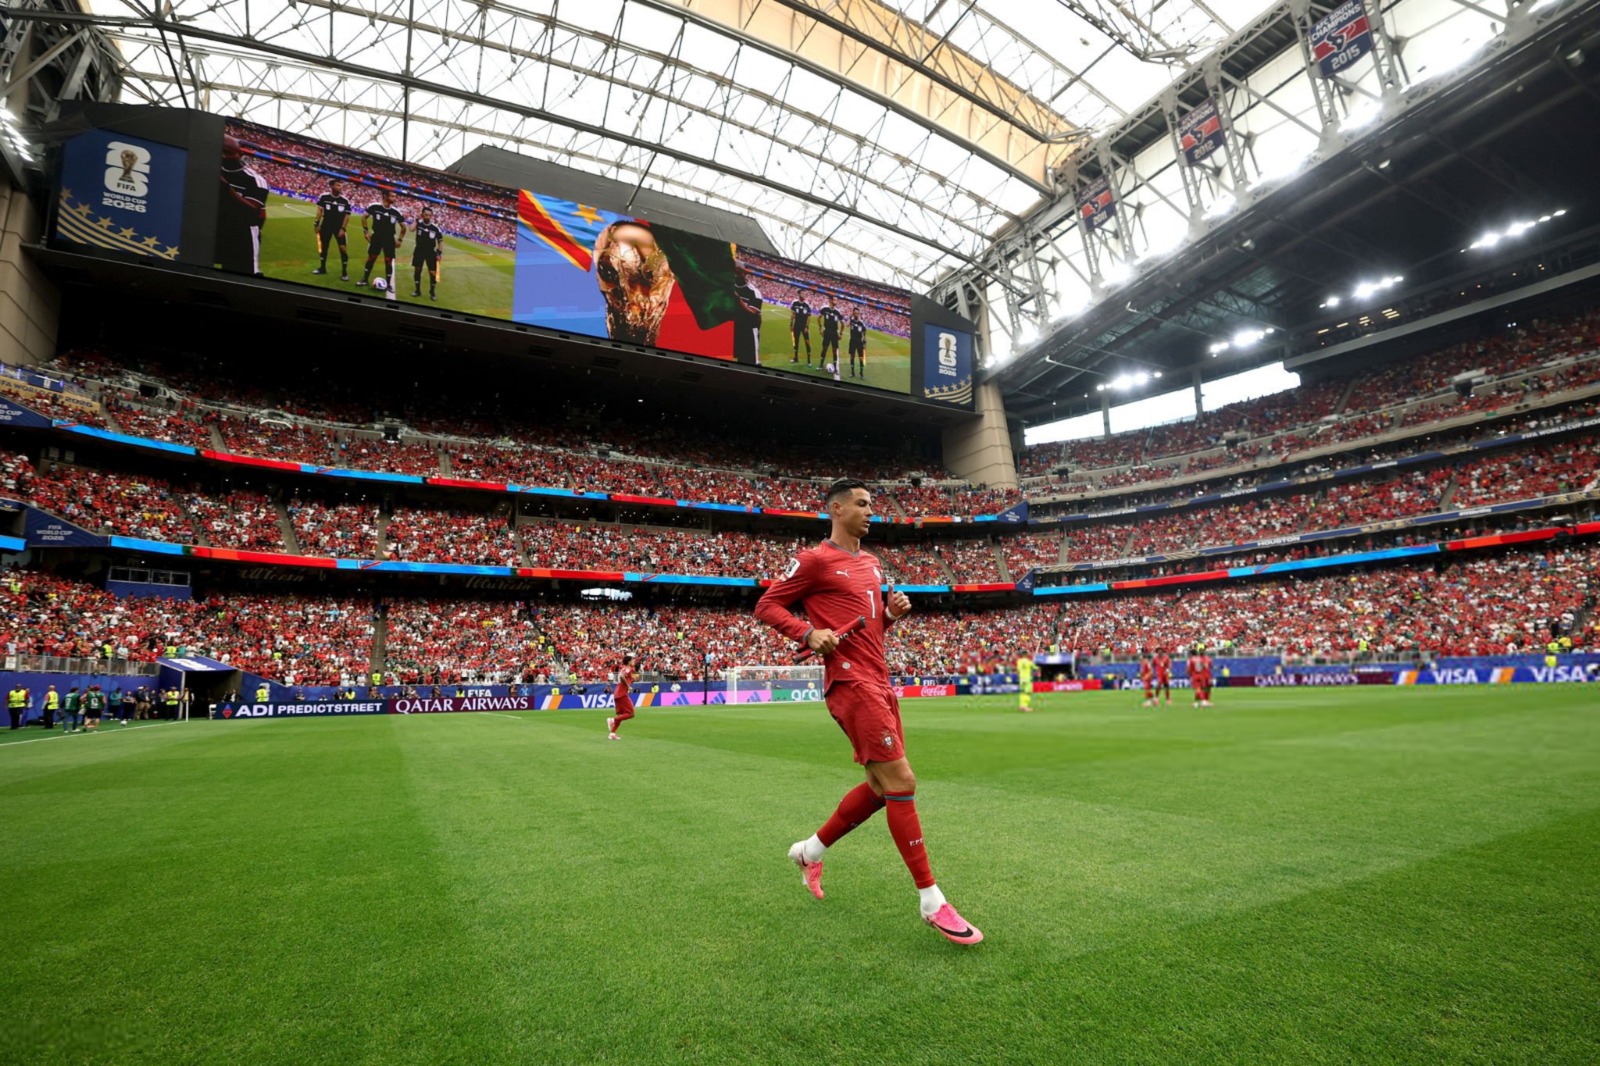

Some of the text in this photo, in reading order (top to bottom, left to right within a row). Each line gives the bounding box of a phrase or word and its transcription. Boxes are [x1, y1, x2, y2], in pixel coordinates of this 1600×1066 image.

[1329, 1, 1354, 21] SOUTH
[1311, 4, 1361, 41] CHAMPIONS
[1331, 44, 1361, 70] 2015
[1193, 140, 1215, 159] 2012
[117, 182, 136, 191] FIFA
[103, 191, 131, 202] WORLD
[102, 197, 147, 213] 2026
[1521, 431, 1538, 439] FIFA
[1540, 425, 1567, 436] WORLD
[1567, 421, 1583, 431] CUP
[1221, 487, 1257, 498] HOUSTON
[1257, 536, 1300, 546] HOUSTON
[1254, 675, 1297, 687] QATAR
[1432, 669, 1479, 684] VISA
[1528, 665, 1587, 683] VISA
[467, 689, 493, 698] FIFA
[579, 693, 616, 708] VISA
[235, 702, 383, 717] ADI PREDICTSTREET
[395, 696, 528, 715] QATAR AIRWAYS
